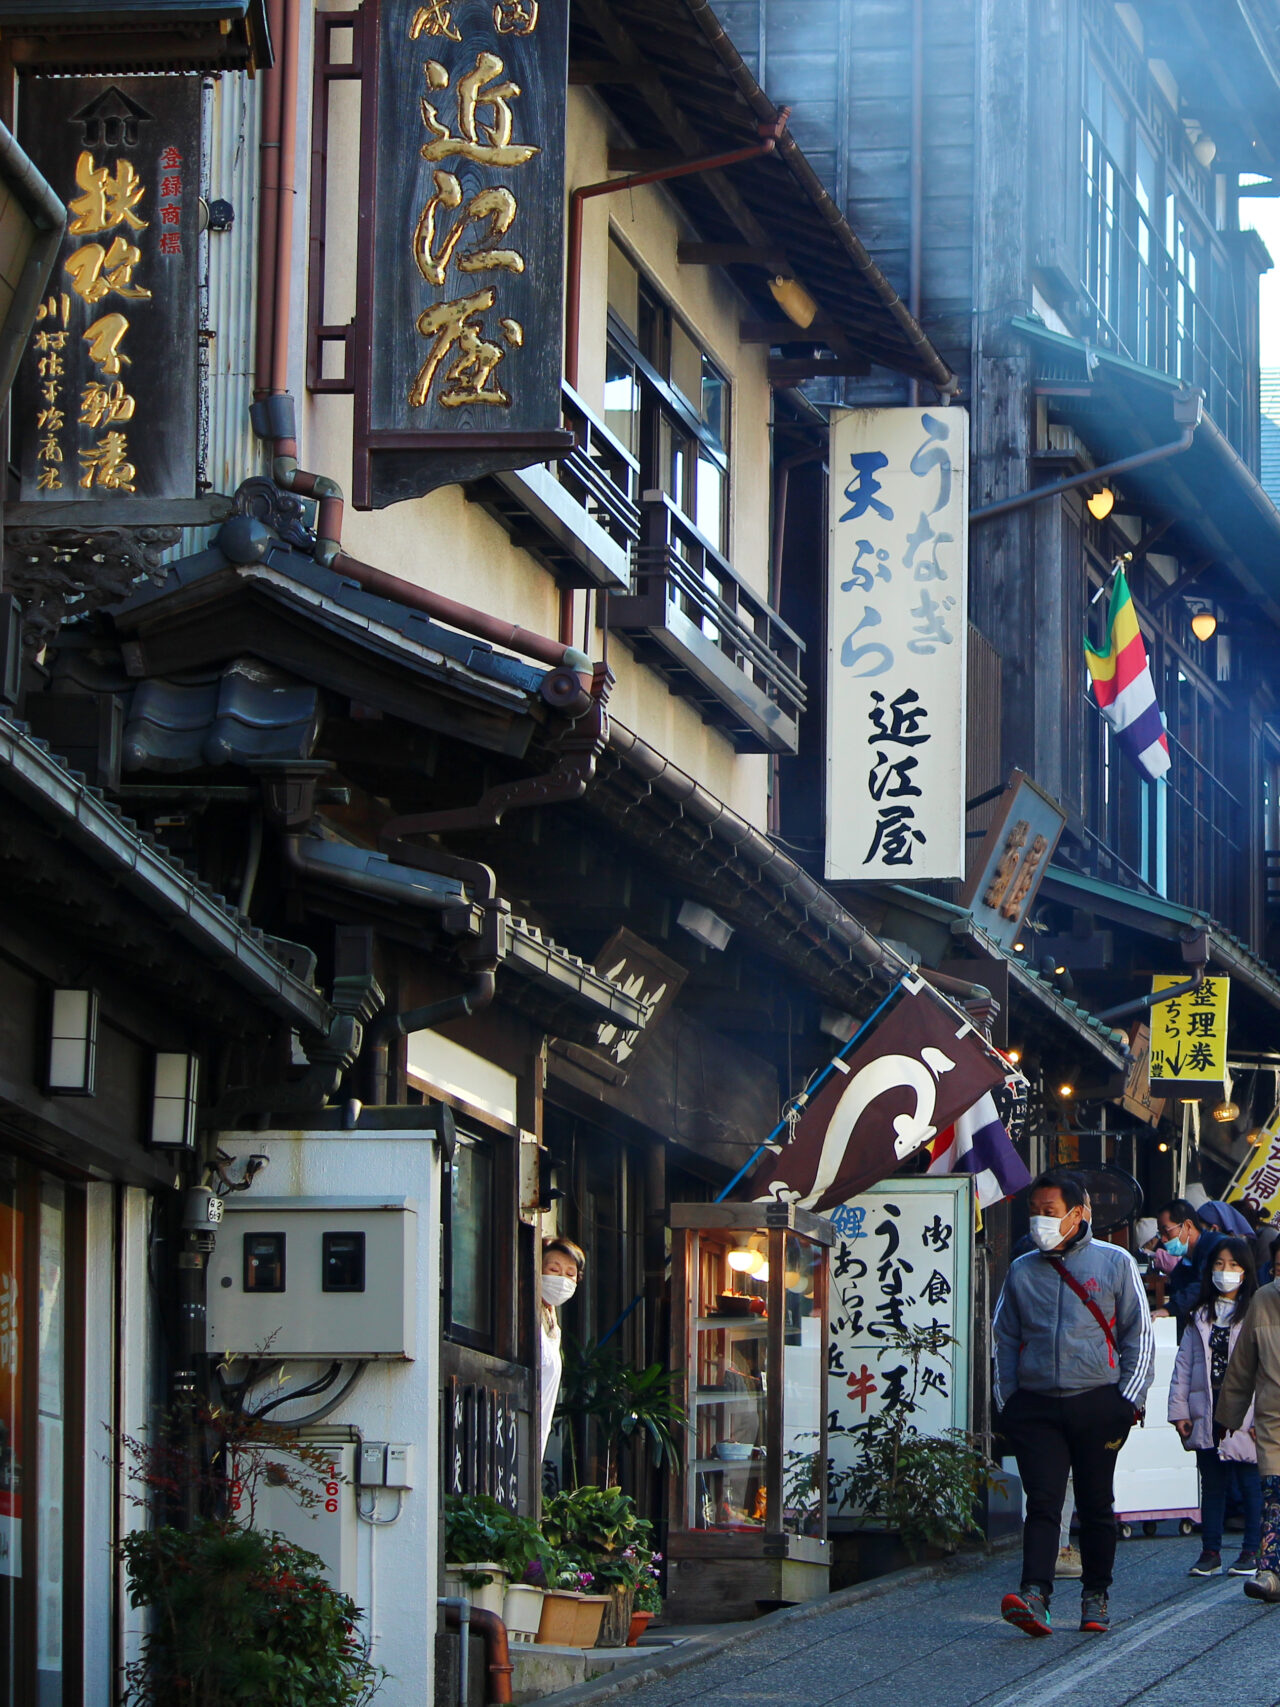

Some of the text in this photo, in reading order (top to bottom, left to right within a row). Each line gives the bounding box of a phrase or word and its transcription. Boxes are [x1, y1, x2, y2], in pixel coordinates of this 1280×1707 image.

[160, 146, 183, 256] 登録商標
[409, 51, 541, 408] 近江屋
[839, 451, 896, 679] 天ぷら
[901, 413, 957, 656] うなぎ
[863, 687, 932, 867] 近江屋
[1150, 1049, 1164, 1079] 川豊
[1185, 978, 1218, 1073] 整理券
[867, 1203, 917, 1339] うなぎ
[920, 1214, 953, 1398] 御食事処
